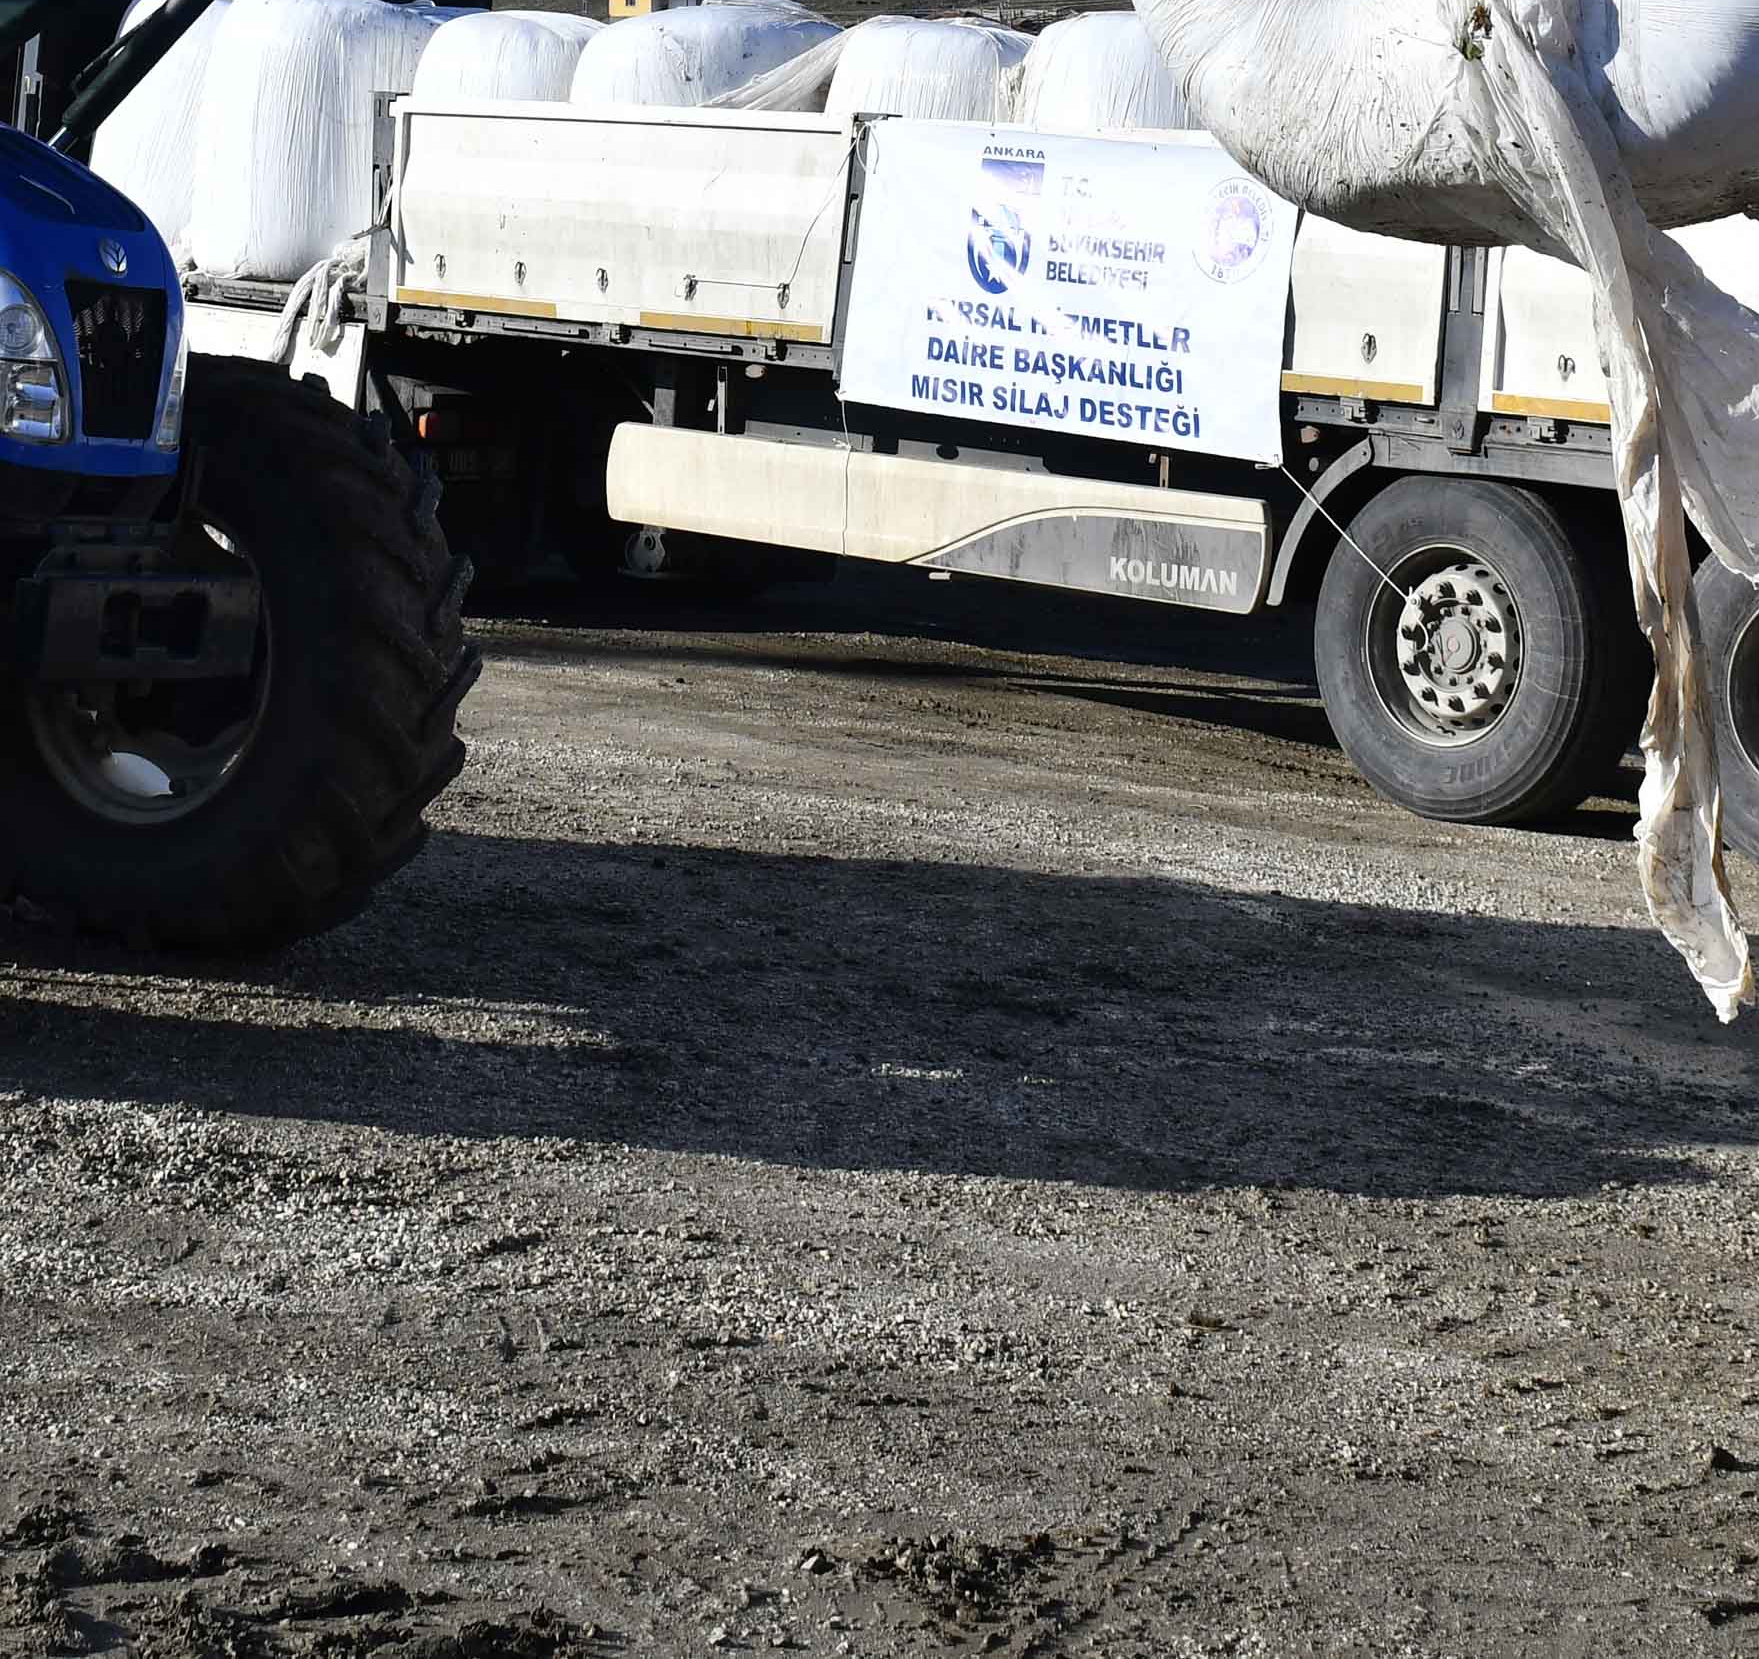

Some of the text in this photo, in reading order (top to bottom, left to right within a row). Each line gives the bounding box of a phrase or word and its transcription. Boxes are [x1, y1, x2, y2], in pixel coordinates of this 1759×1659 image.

[983, 145, 1046, 160] ANKARA
[927, 299, 1021, 332] KRSAL
[927, 335, 1183, 394] DAİRE BAŞKANLIĞI
[911, 374, 1201, 439] MISIR SİLAJ DESTEĞİ
[1110, 555, 1237, 597] KOLUMAN
